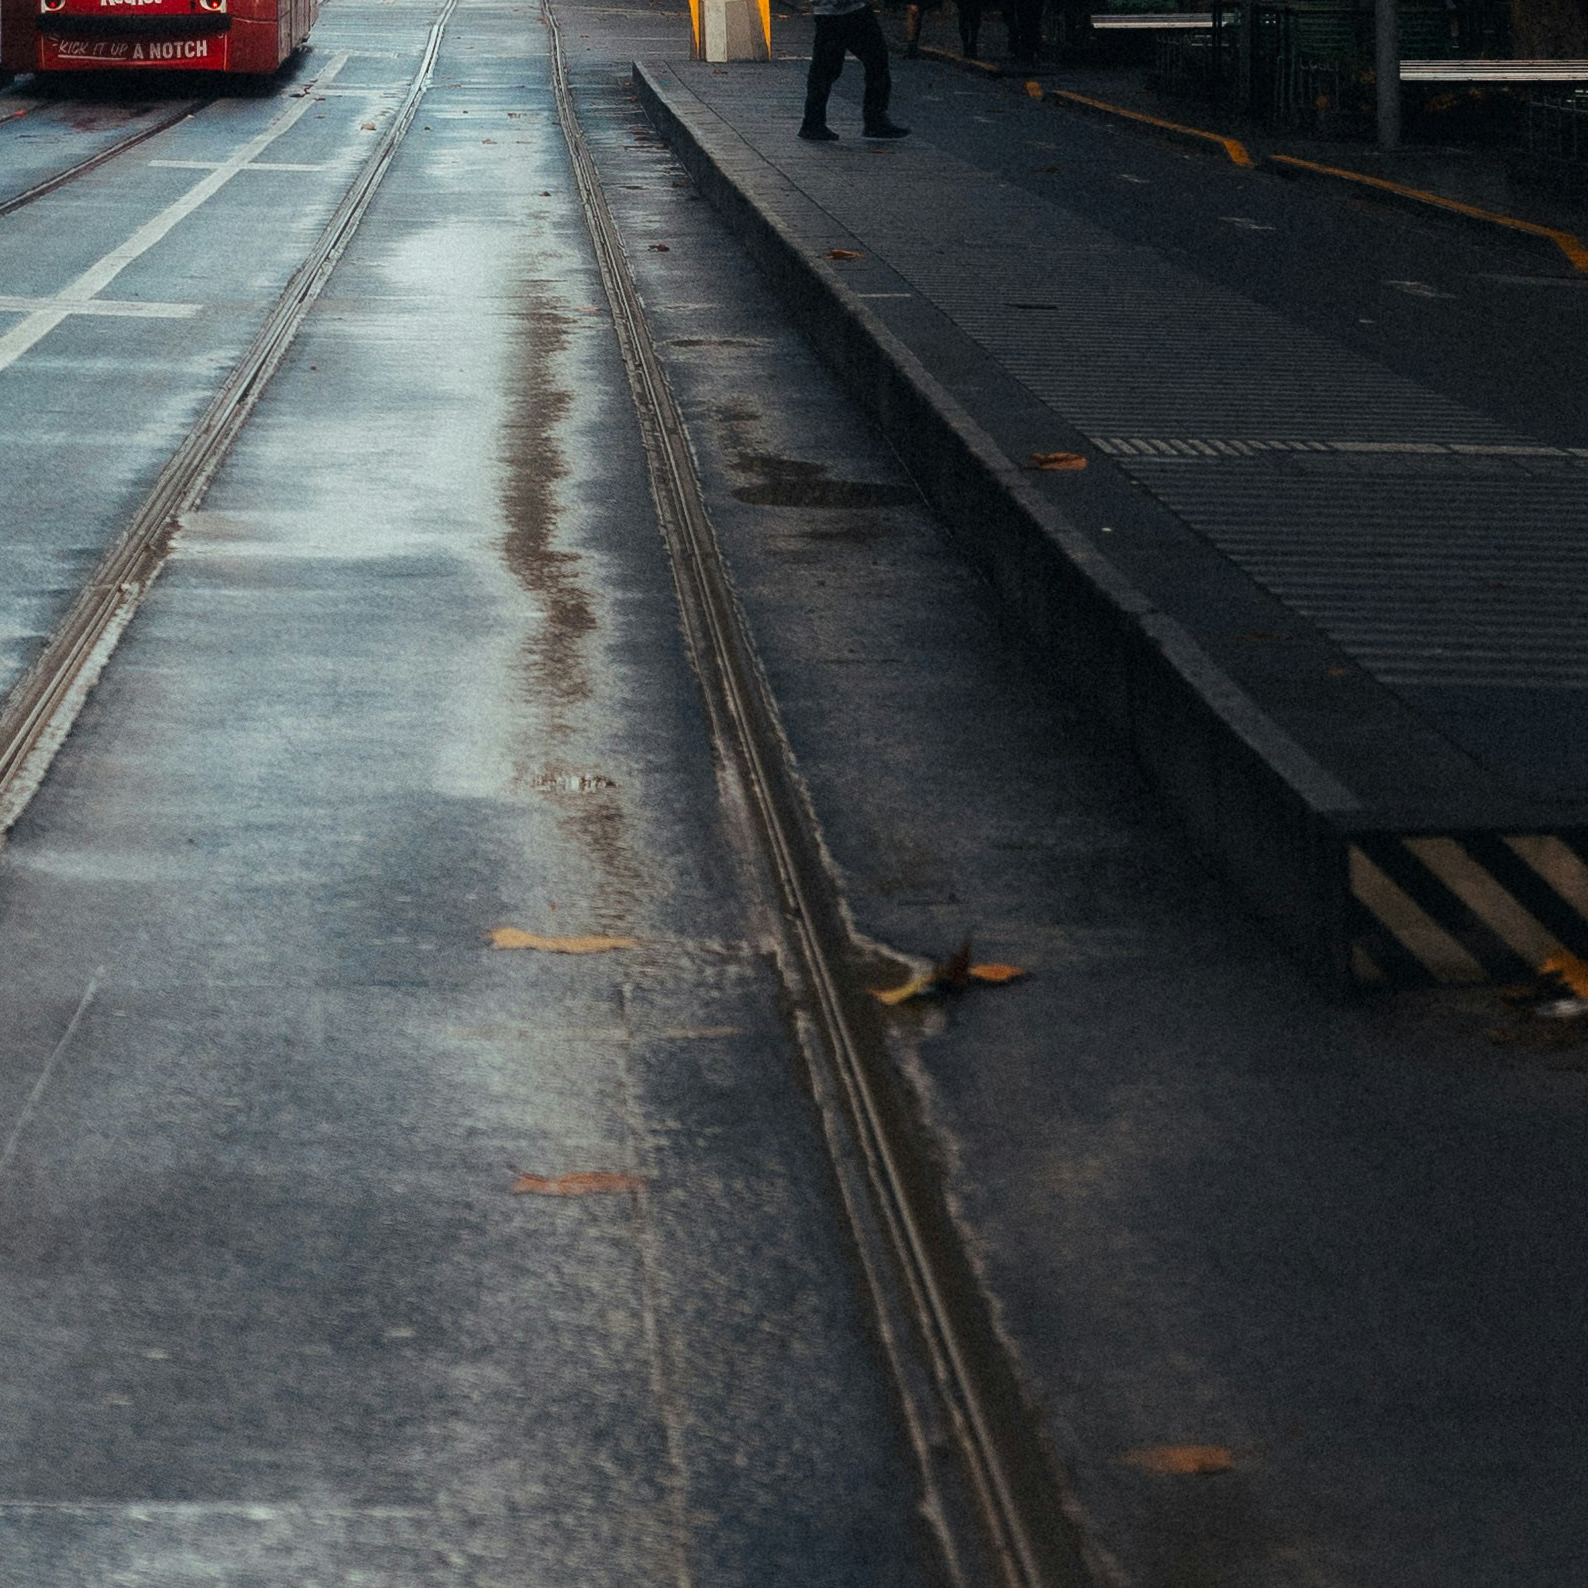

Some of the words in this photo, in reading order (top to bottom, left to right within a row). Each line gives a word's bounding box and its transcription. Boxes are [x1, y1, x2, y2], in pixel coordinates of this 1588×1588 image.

[57, 39, 89, 55] KICK
[92, 42, 106, 56] IT
[110, 42, 129, 56] UP
[132, 42, 144, 59] A
[149, 39, 208, 60] NOTCH
